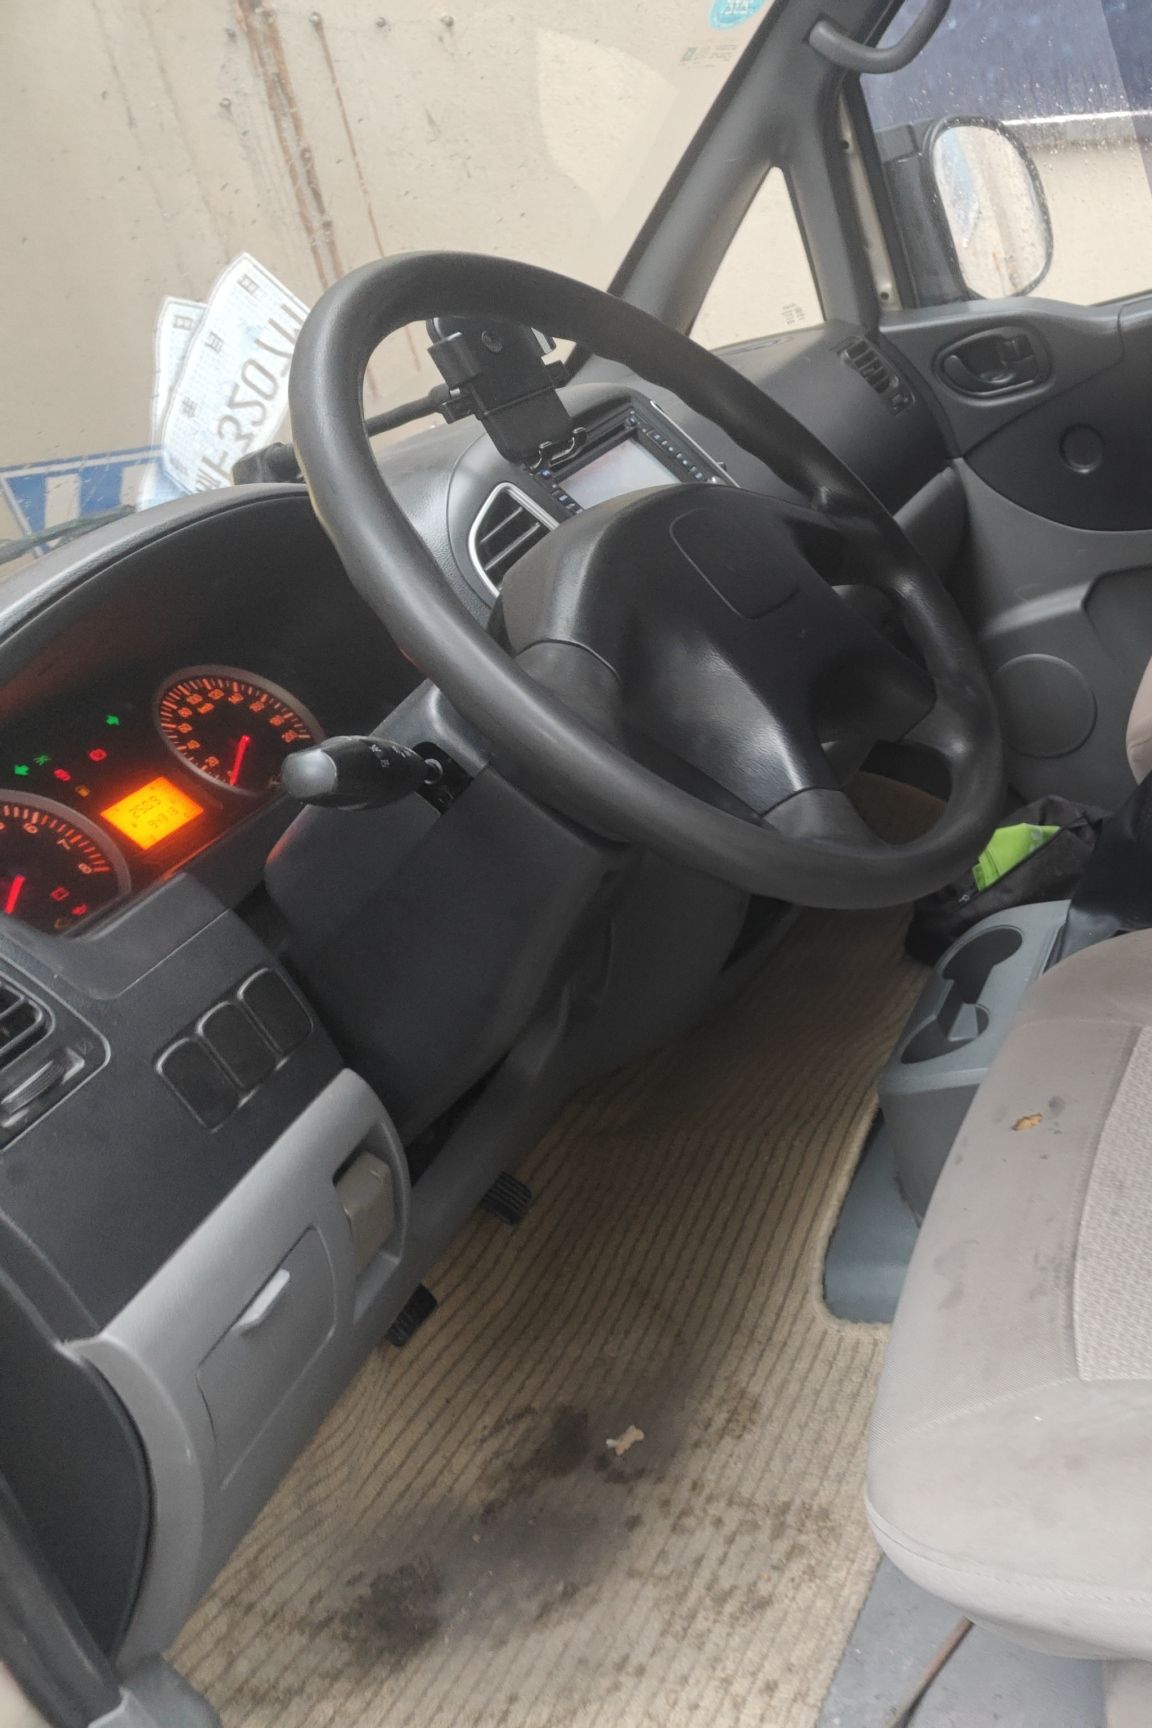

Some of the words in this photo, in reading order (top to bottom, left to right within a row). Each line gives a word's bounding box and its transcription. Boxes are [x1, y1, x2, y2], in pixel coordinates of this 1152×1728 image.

[23, 822, 38, 833] 6
[57, 838, 71, 850] 7
[78, 863, 92, 874] 8
